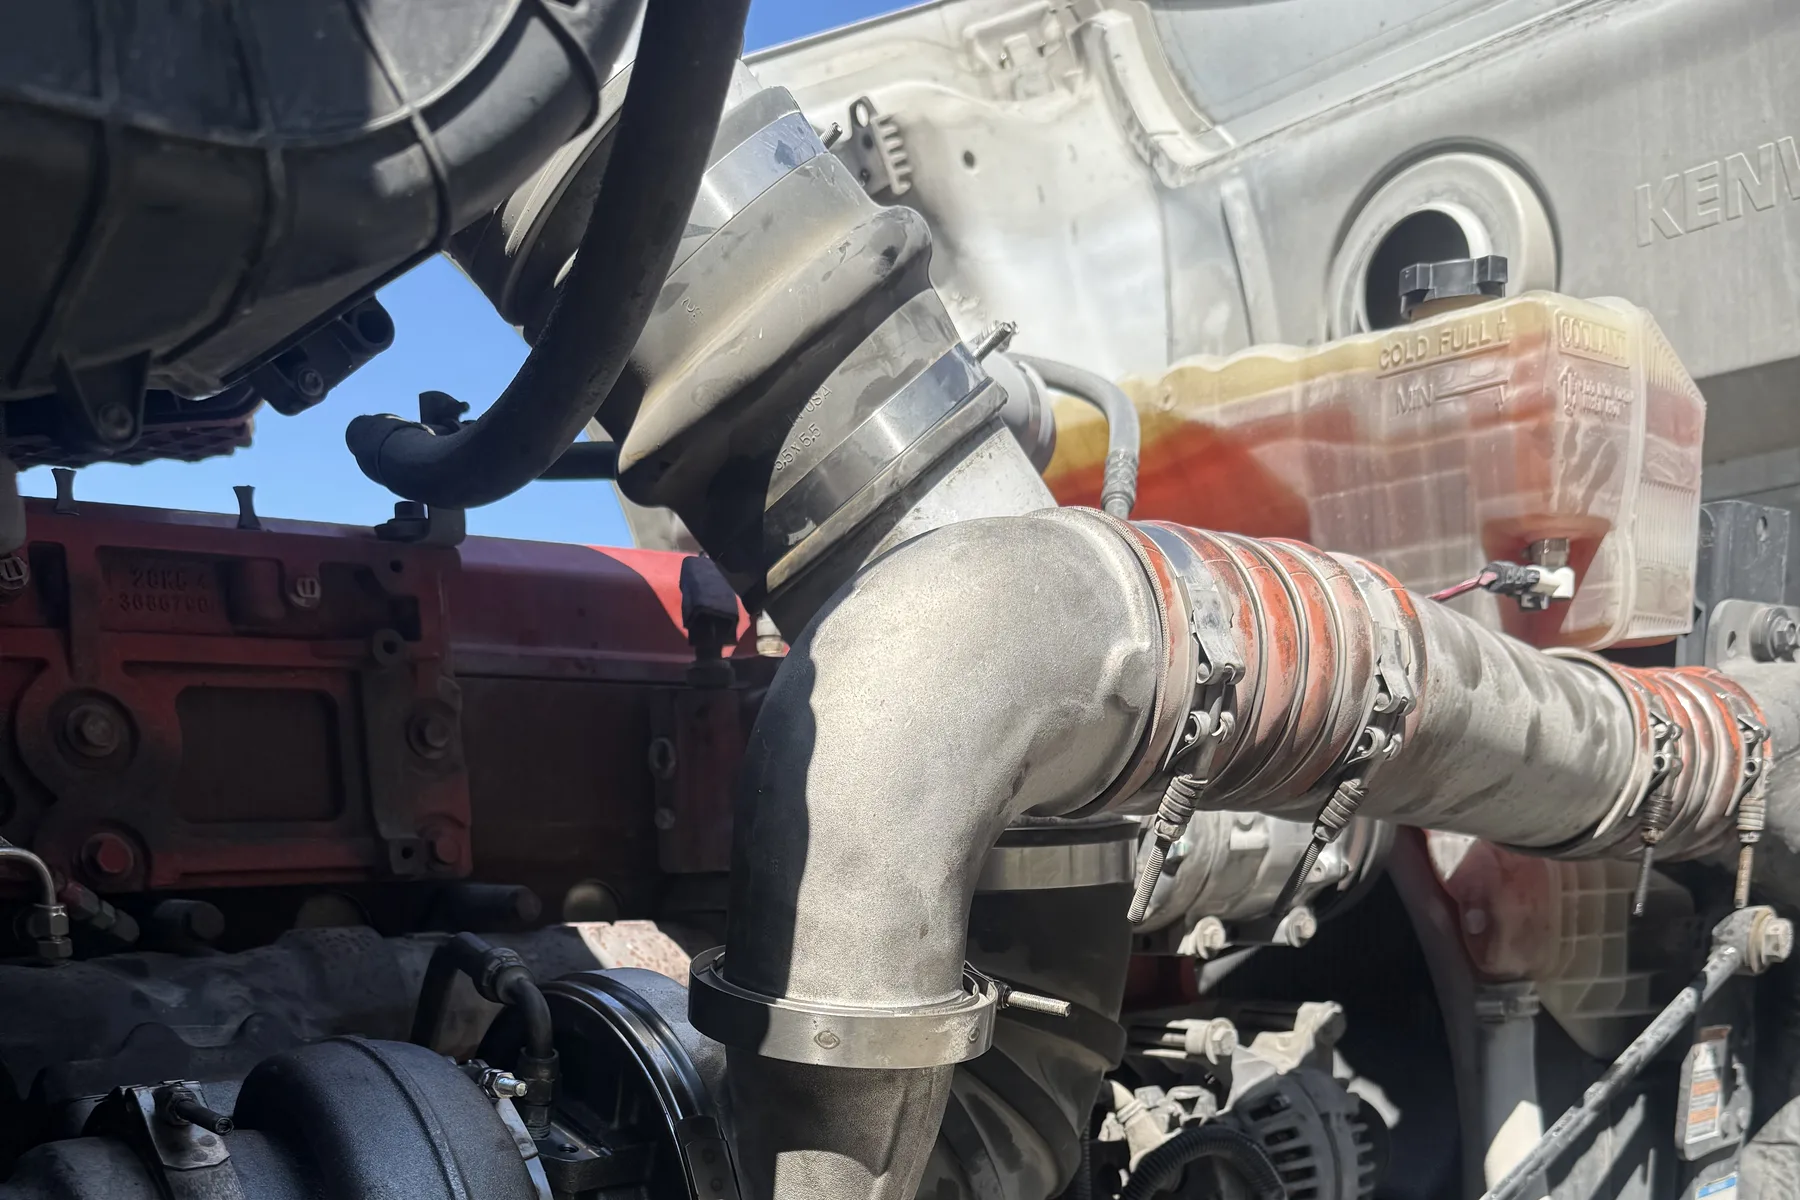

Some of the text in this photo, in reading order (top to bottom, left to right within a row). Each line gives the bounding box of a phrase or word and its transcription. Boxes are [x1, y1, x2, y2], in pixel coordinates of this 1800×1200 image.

[1379, 319, 1493, 371] COLD FULL
[1560, 316, 1625, 361] COOLANT
[805, 384, 833, 413] USA
[1395, 381, 1434, 416] MIN
